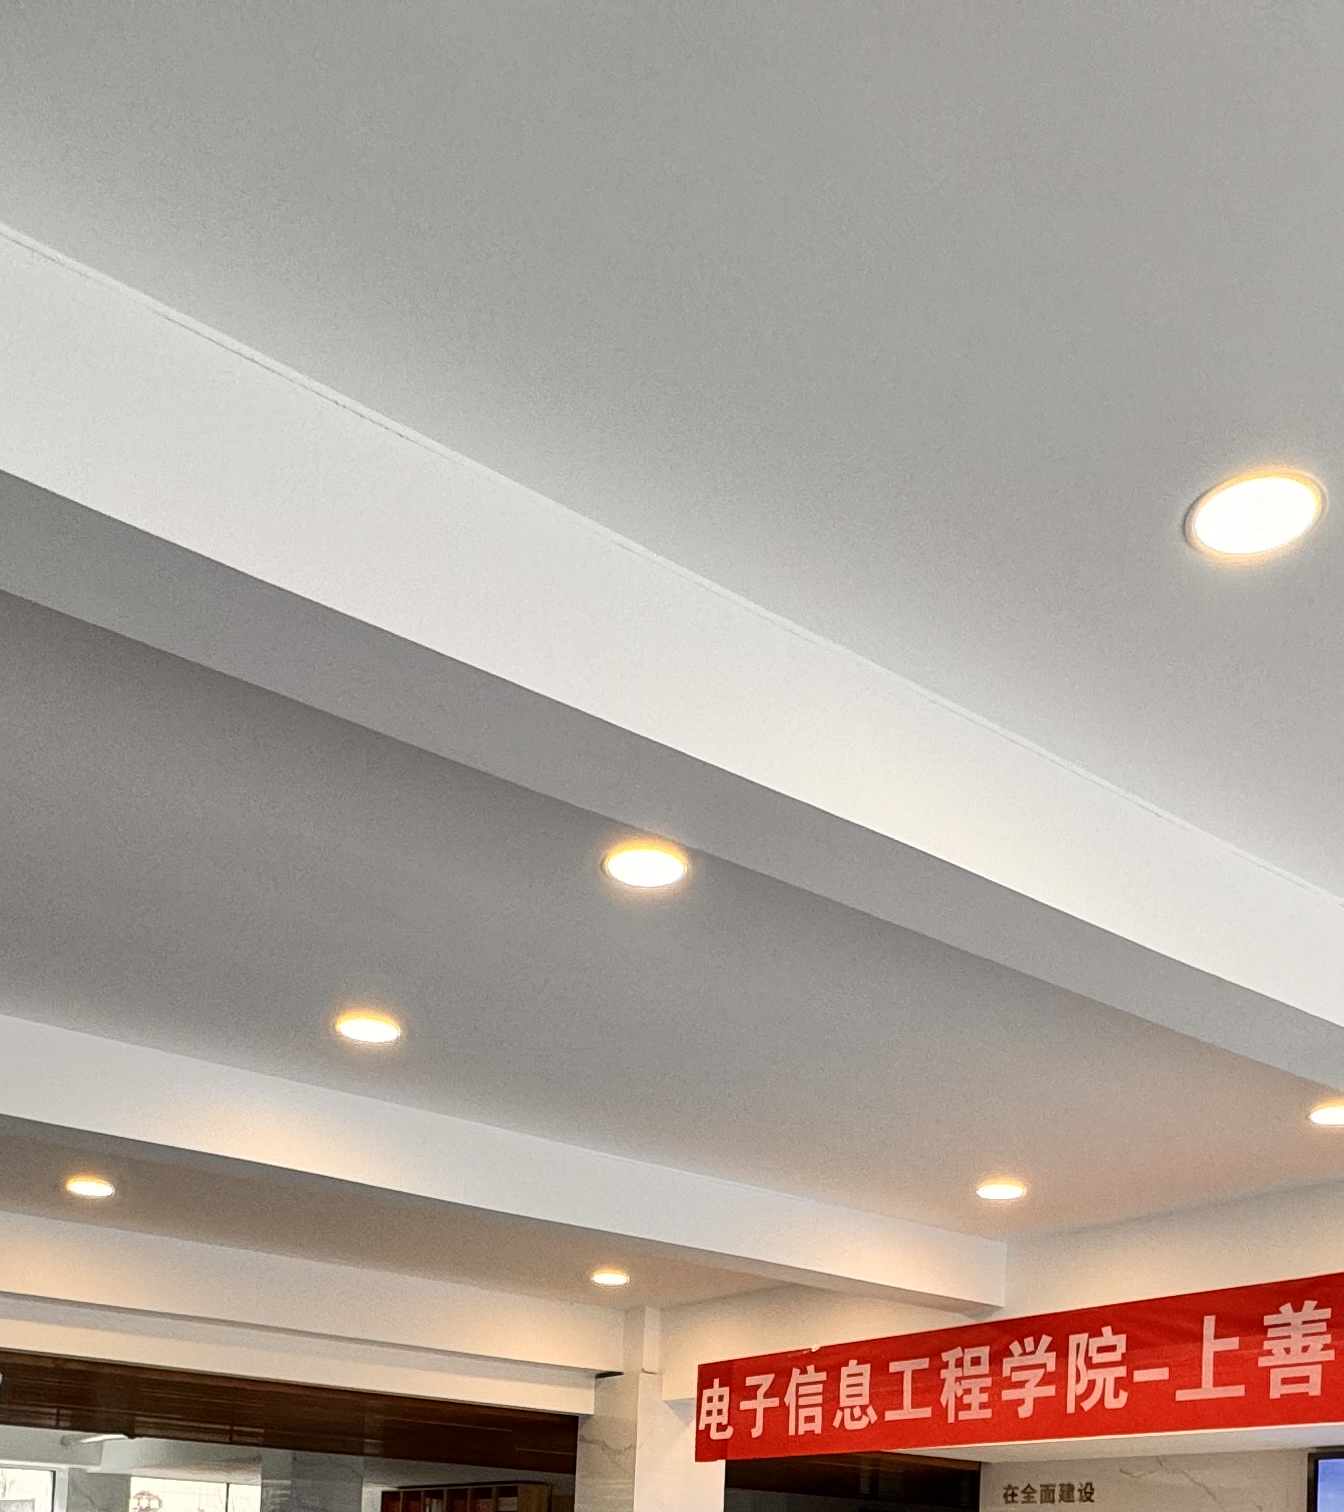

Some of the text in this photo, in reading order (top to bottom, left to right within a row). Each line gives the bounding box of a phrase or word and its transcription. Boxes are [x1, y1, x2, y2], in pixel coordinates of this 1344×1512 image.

[1002, 1482, 1096, 1505] 在全面建设
